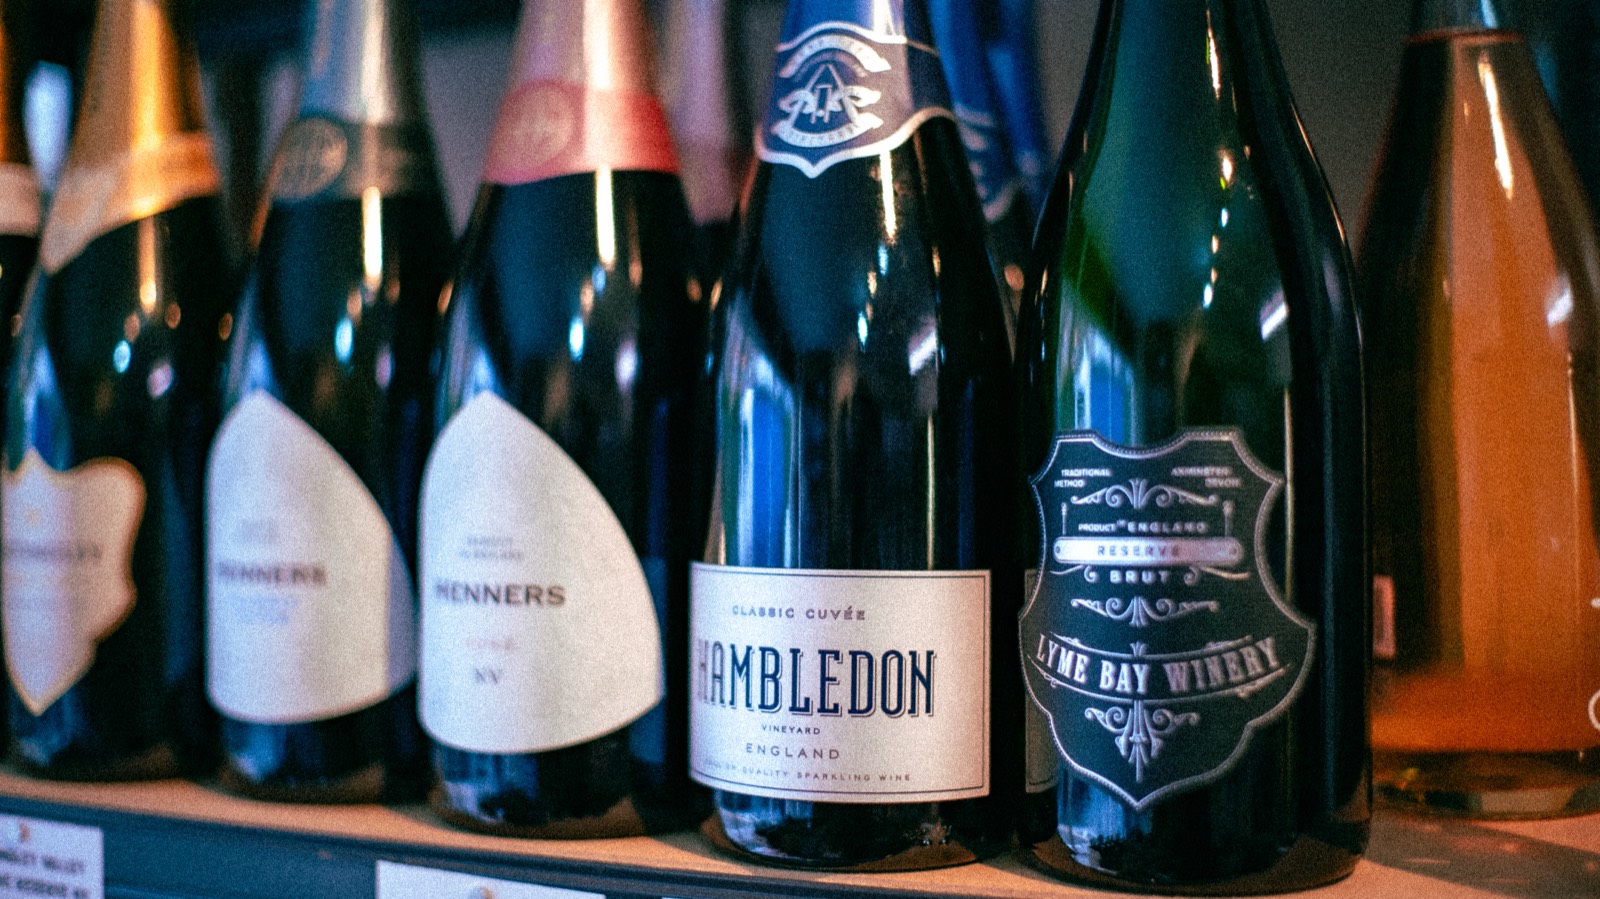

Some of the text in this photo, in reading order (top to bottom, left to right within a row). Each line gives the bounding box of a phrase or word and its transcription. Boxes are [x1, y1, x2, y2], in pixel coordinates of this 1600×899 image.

[1060, 466, 1112, 478] TRADITIONAL
[1170, 466, 1233, 478] AXMINSTER
[1078, 522, 1116, 533] PRODUCT
[1127, 521, 1208, 533] ENGLAND
[1096, 544, 1182, 557] RESERVE
[1109, 569, 1171, 584] BRUT
[434, 578, 568, 609] HENNERS
[732, 604, 867, 621] CLASSIC CUVÉE
[1035, 632, 1281, 695] LYME BAY WINERY
[698, 637, 937, 719] HAMBLEDON
[761, 723, 822, 736] VINEYARD
[745, 742, 841, 760] ENGLAND
[742, 766, 911, 782] QUALITY SPARKLING WINE
